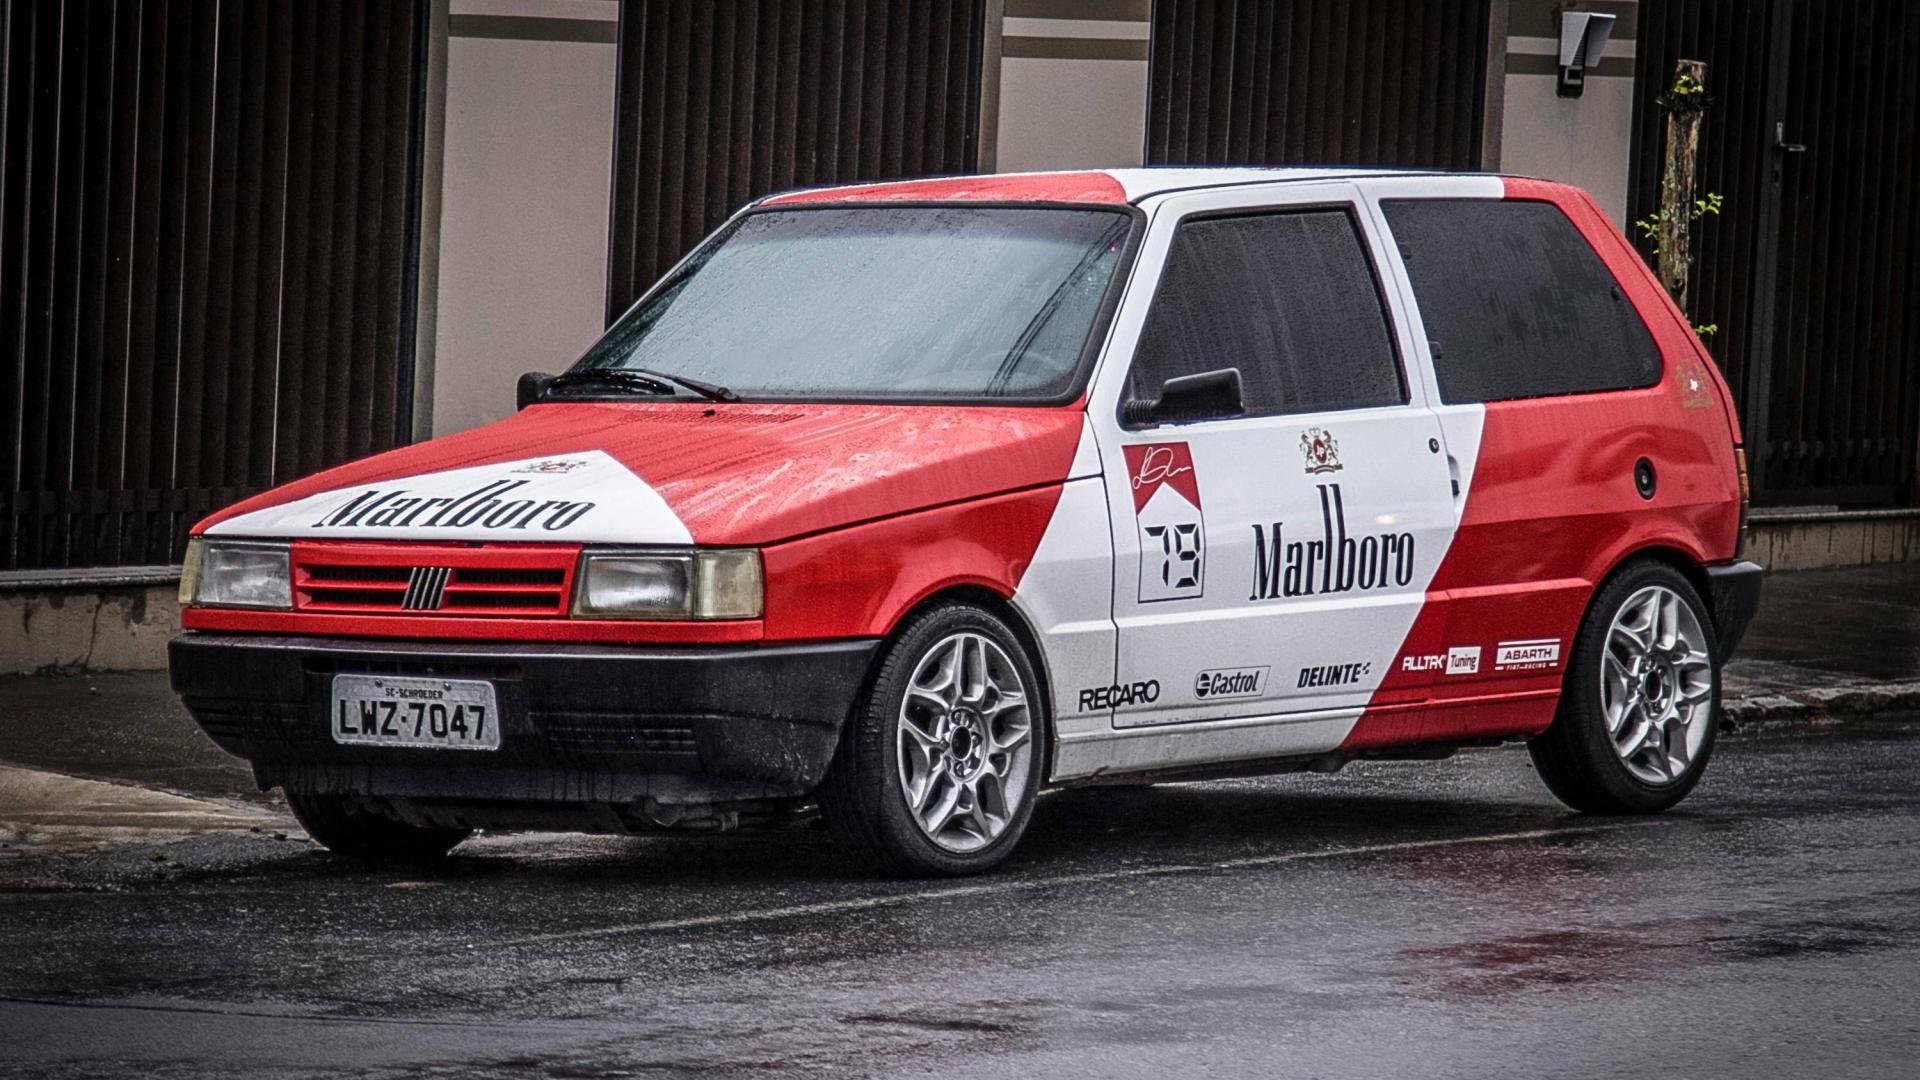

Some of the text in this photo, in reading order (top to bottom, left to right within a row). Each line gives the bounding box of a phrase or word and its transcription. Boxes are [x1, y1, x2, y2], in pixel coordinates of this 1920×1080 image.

[311, 479, 597, 531] Marlboro
[1144, 523, 1200, 589] 79
[1249, 483, 1415, 601] Marlboro
[1450, 653, 1477, 671] Tuning
[1504, 648, 1553, 661] ABARTH
[1210, 670, 1260, 696] Castrol
[1297, 662, 1363, 689] DELINTE
[1078, 679, 1161, 713] RECARO
